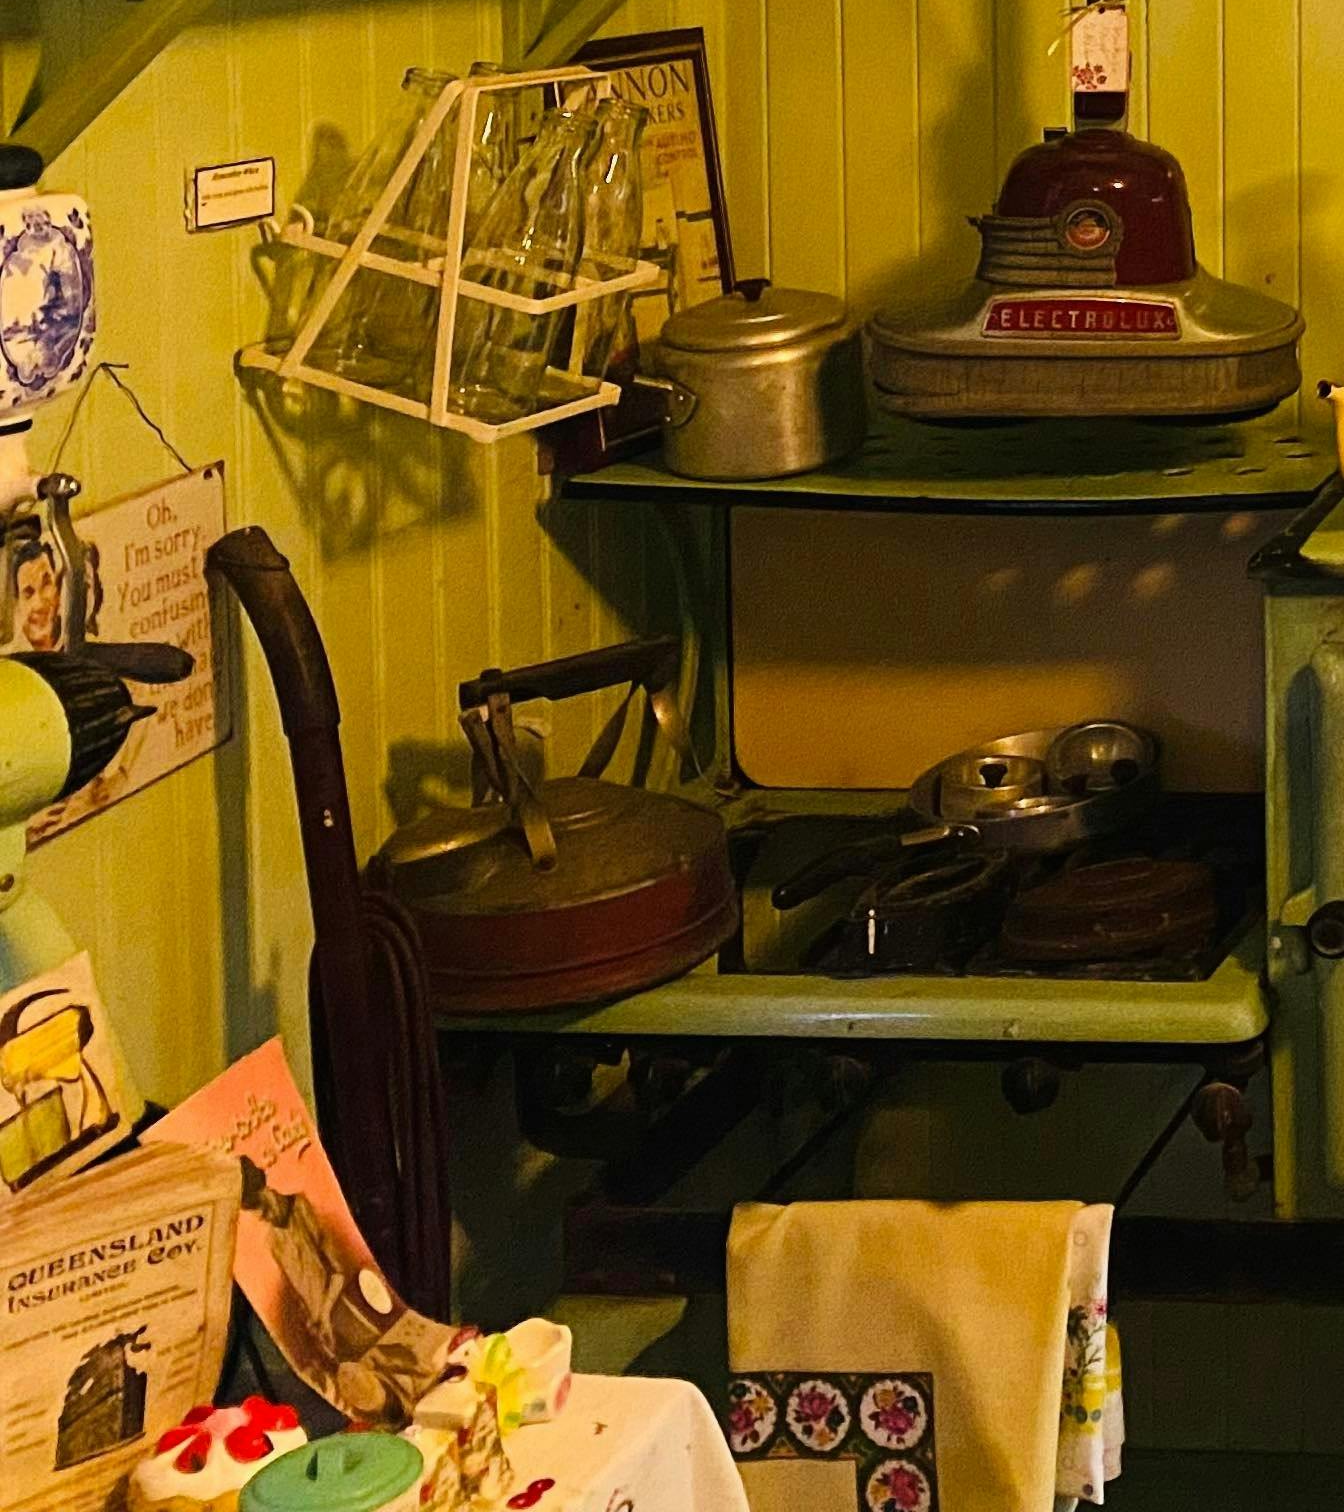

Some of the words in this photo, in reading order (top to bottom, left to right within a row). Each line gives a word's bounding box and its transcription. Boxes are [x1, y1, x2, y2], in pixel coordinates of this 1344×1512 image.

[999, 309, 1167, 333] ELECTROLUX
[123, 541, 152, 573] I'm
[117, 579, 152, 614] You
[154, 559, 201, 599] must
[7, 1214, 204, 1292] QUEENSLAND
[7, 1258, 137, 1315] INSURANCE
